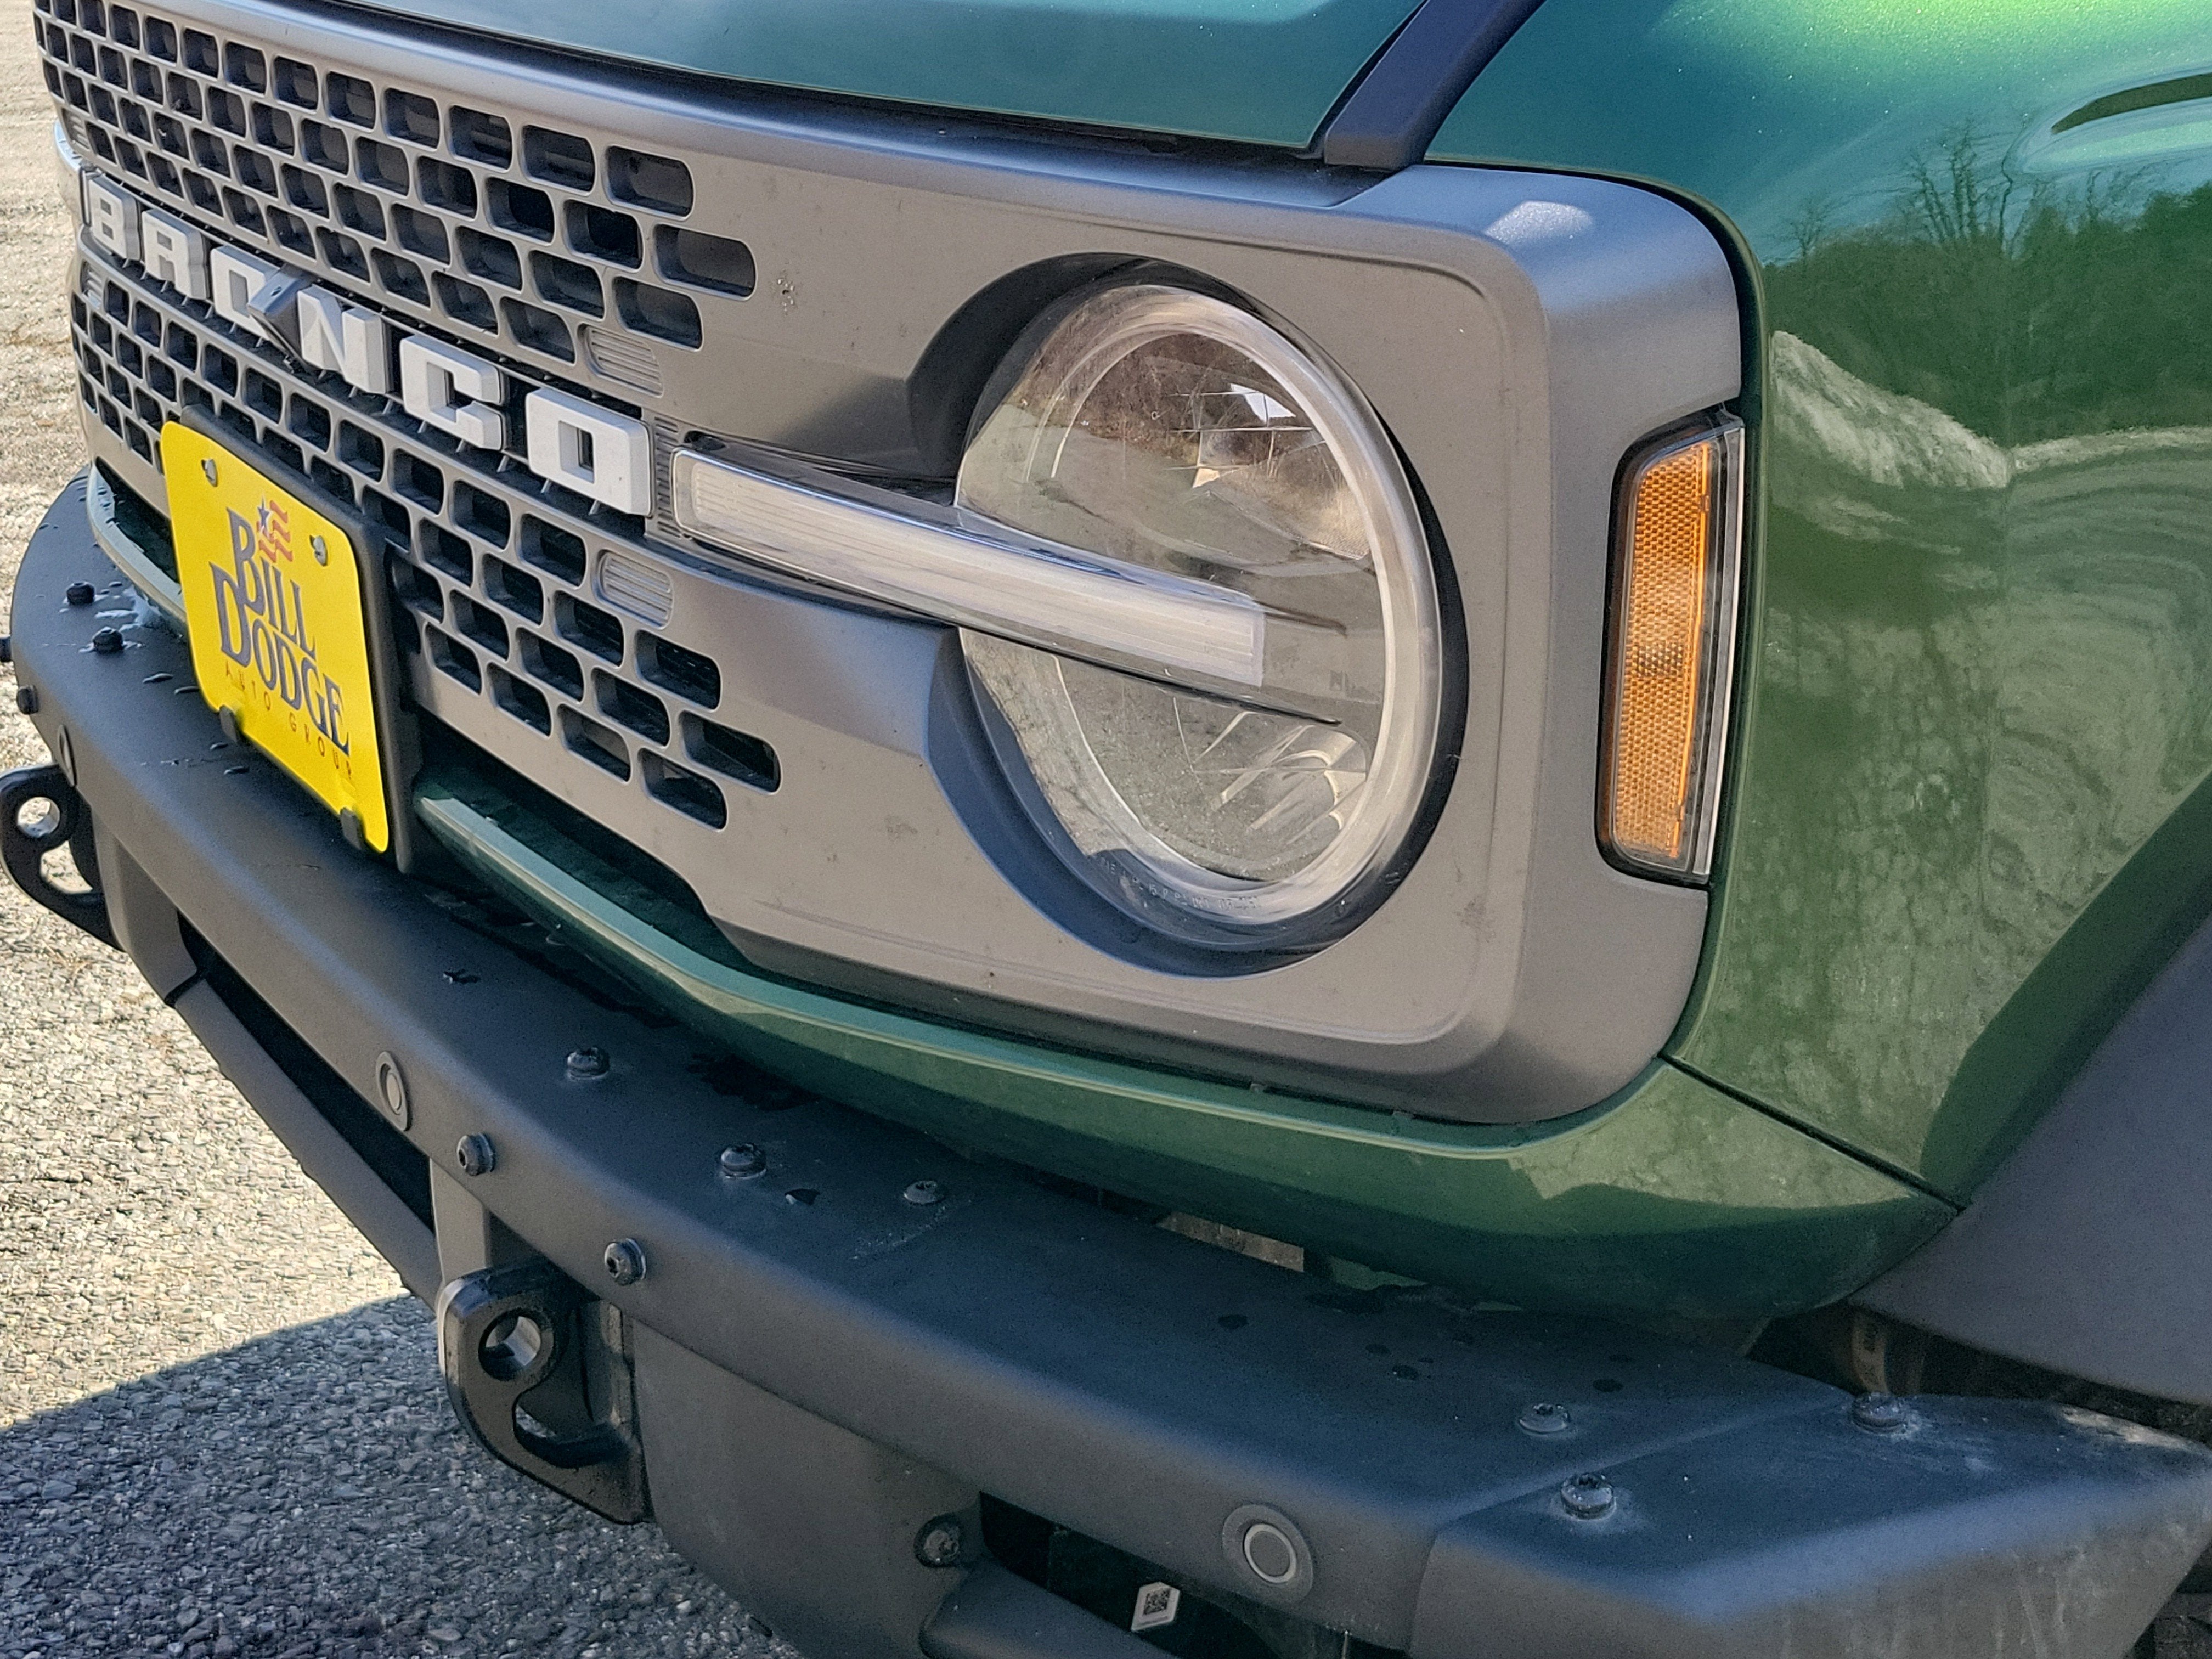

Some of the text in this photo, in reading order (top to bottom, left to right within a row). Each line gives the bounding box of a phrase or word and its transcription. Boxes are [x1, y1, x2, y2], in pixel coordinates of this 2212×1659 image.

[88, 174, 651, 516] BRONCO
[210, 562, 350, 756] DODGE
[226, 507, 317, 661] BILL
[225, 659, 352, 780] AUTO GROUP
